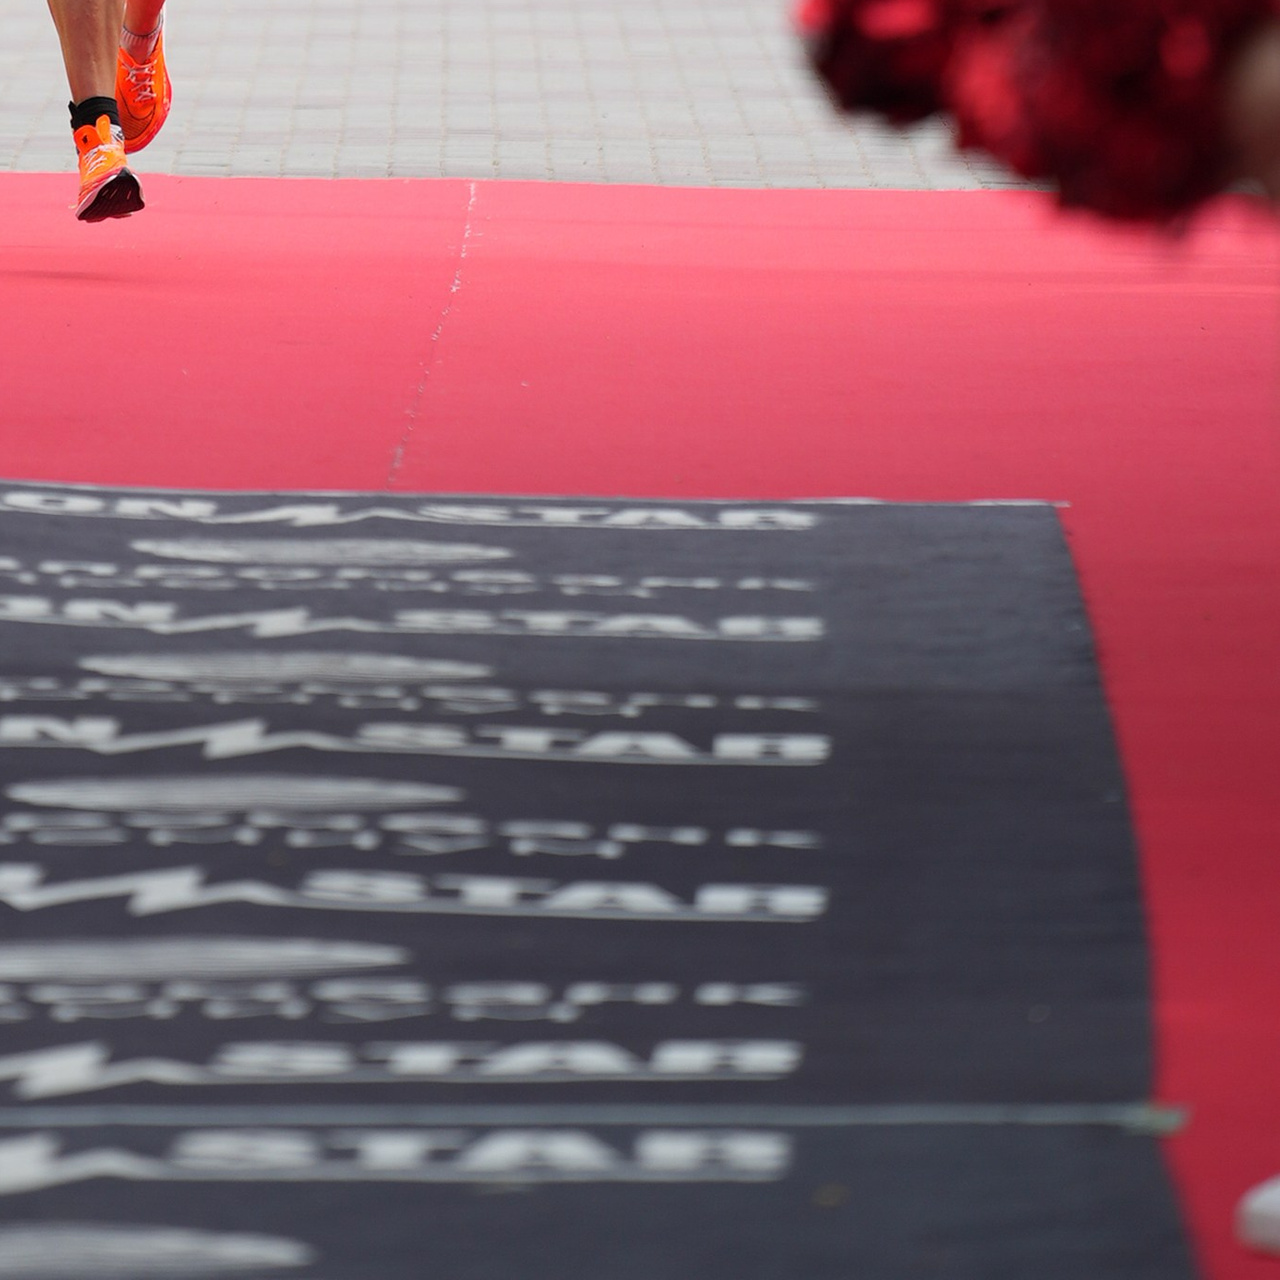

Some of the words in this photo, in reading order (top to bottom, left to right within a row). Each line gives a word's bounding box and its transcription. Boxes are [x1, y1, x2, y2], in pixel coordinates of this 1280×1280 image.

[419, 503, 816, 527] STAR
[394, 609, 822, 636] STAR
[357, 723, 828, 760] STAR
[303, 868, 826, 915] STAR
[212, 1038, 798, 1076] STAR
[172, 1128, 792, 1172] STAR
